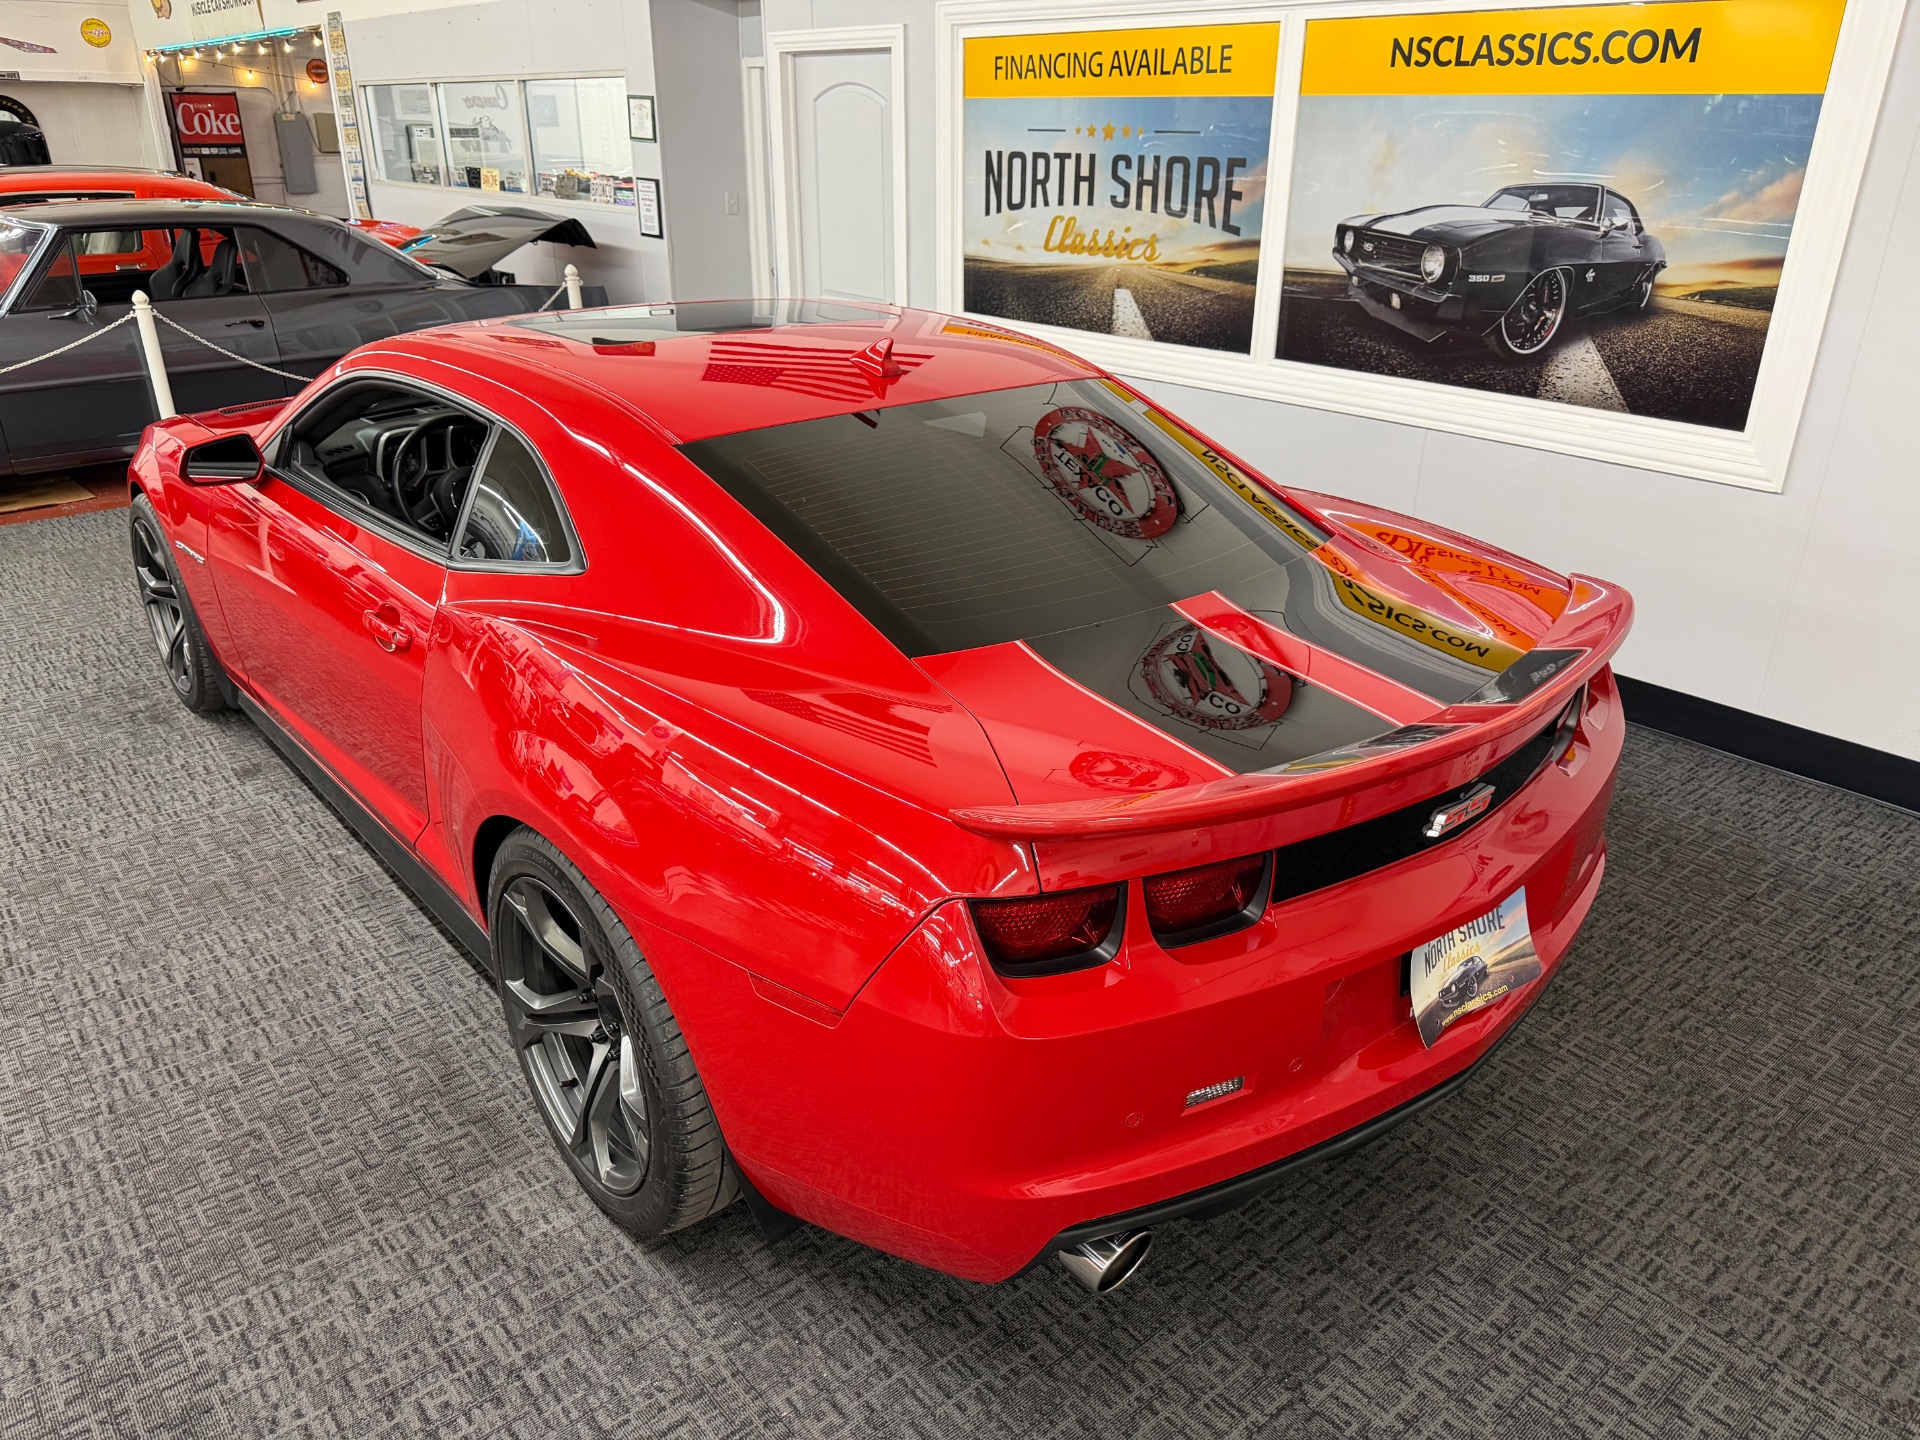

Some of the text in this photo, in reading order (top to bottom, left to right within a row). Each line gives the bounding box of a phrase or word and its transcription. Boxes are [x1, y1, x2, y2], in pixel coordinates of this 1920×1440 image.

[994, 45, 1233, 80] FINANCING AVAILABLE
[1390, 27, 1702, 68] NSCLASSICS.COM
[177, 103, 241, 135] Coke
[985, 150, 1247, 237] NORTH SHORE
[1043, 215, 1161, 262] Classics
[1468, 274, 1490, 283] 350
[1424, 904, 1505, 978] NORTH SHORE
[1443, 942, 1482, 972] Classics
[1441, 984, 1509, 1027] www.nsclassics.com
